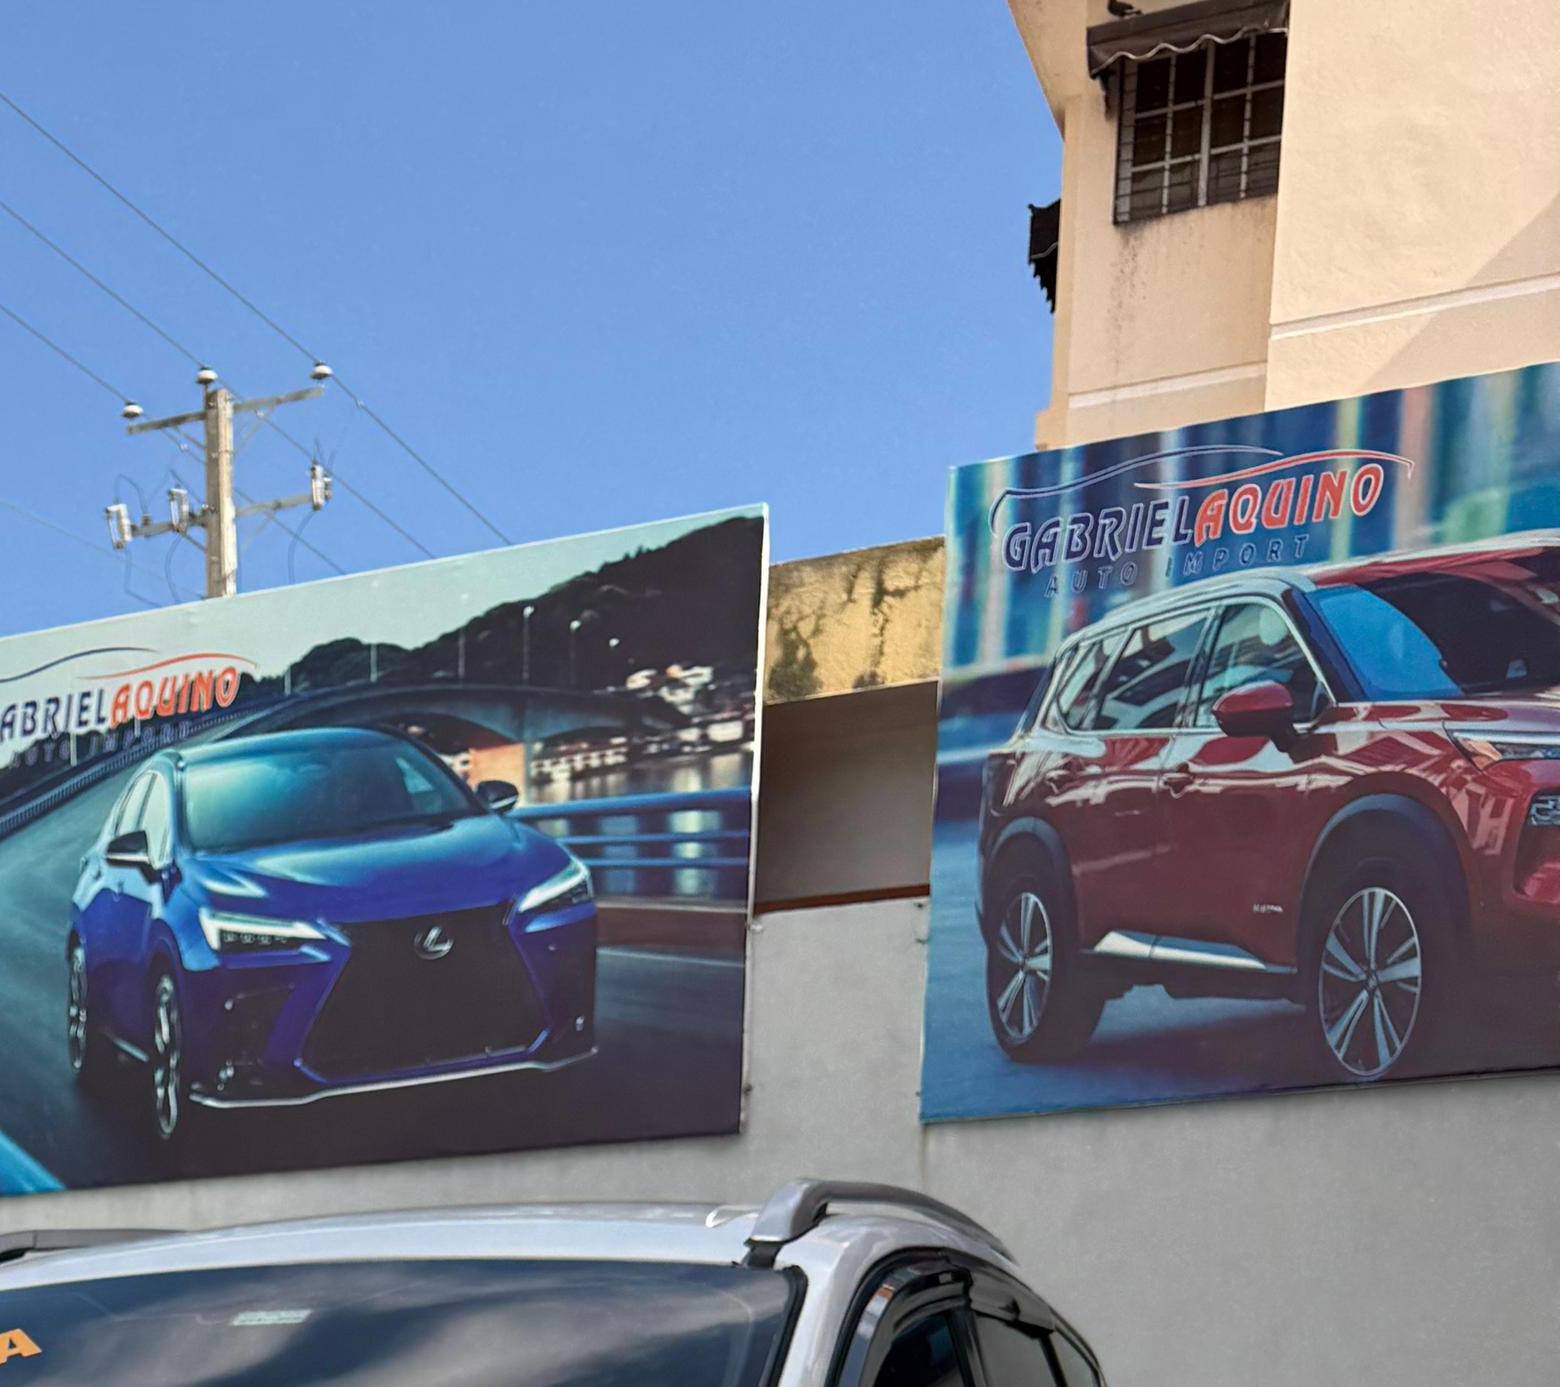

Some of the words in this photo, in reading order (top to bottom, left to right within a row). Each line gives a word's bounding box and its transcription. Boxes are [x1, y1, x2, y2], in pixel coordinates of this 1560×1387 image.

[1003, 496, 1194, 573] GABRIEL
[1194, 463, 1383, 547] AQUINO
[1045, 563, 1138, 599] AUTO
[1166, 534, 1309, 577] IMPORT
[109, 666, 240, 729] AQUINO
